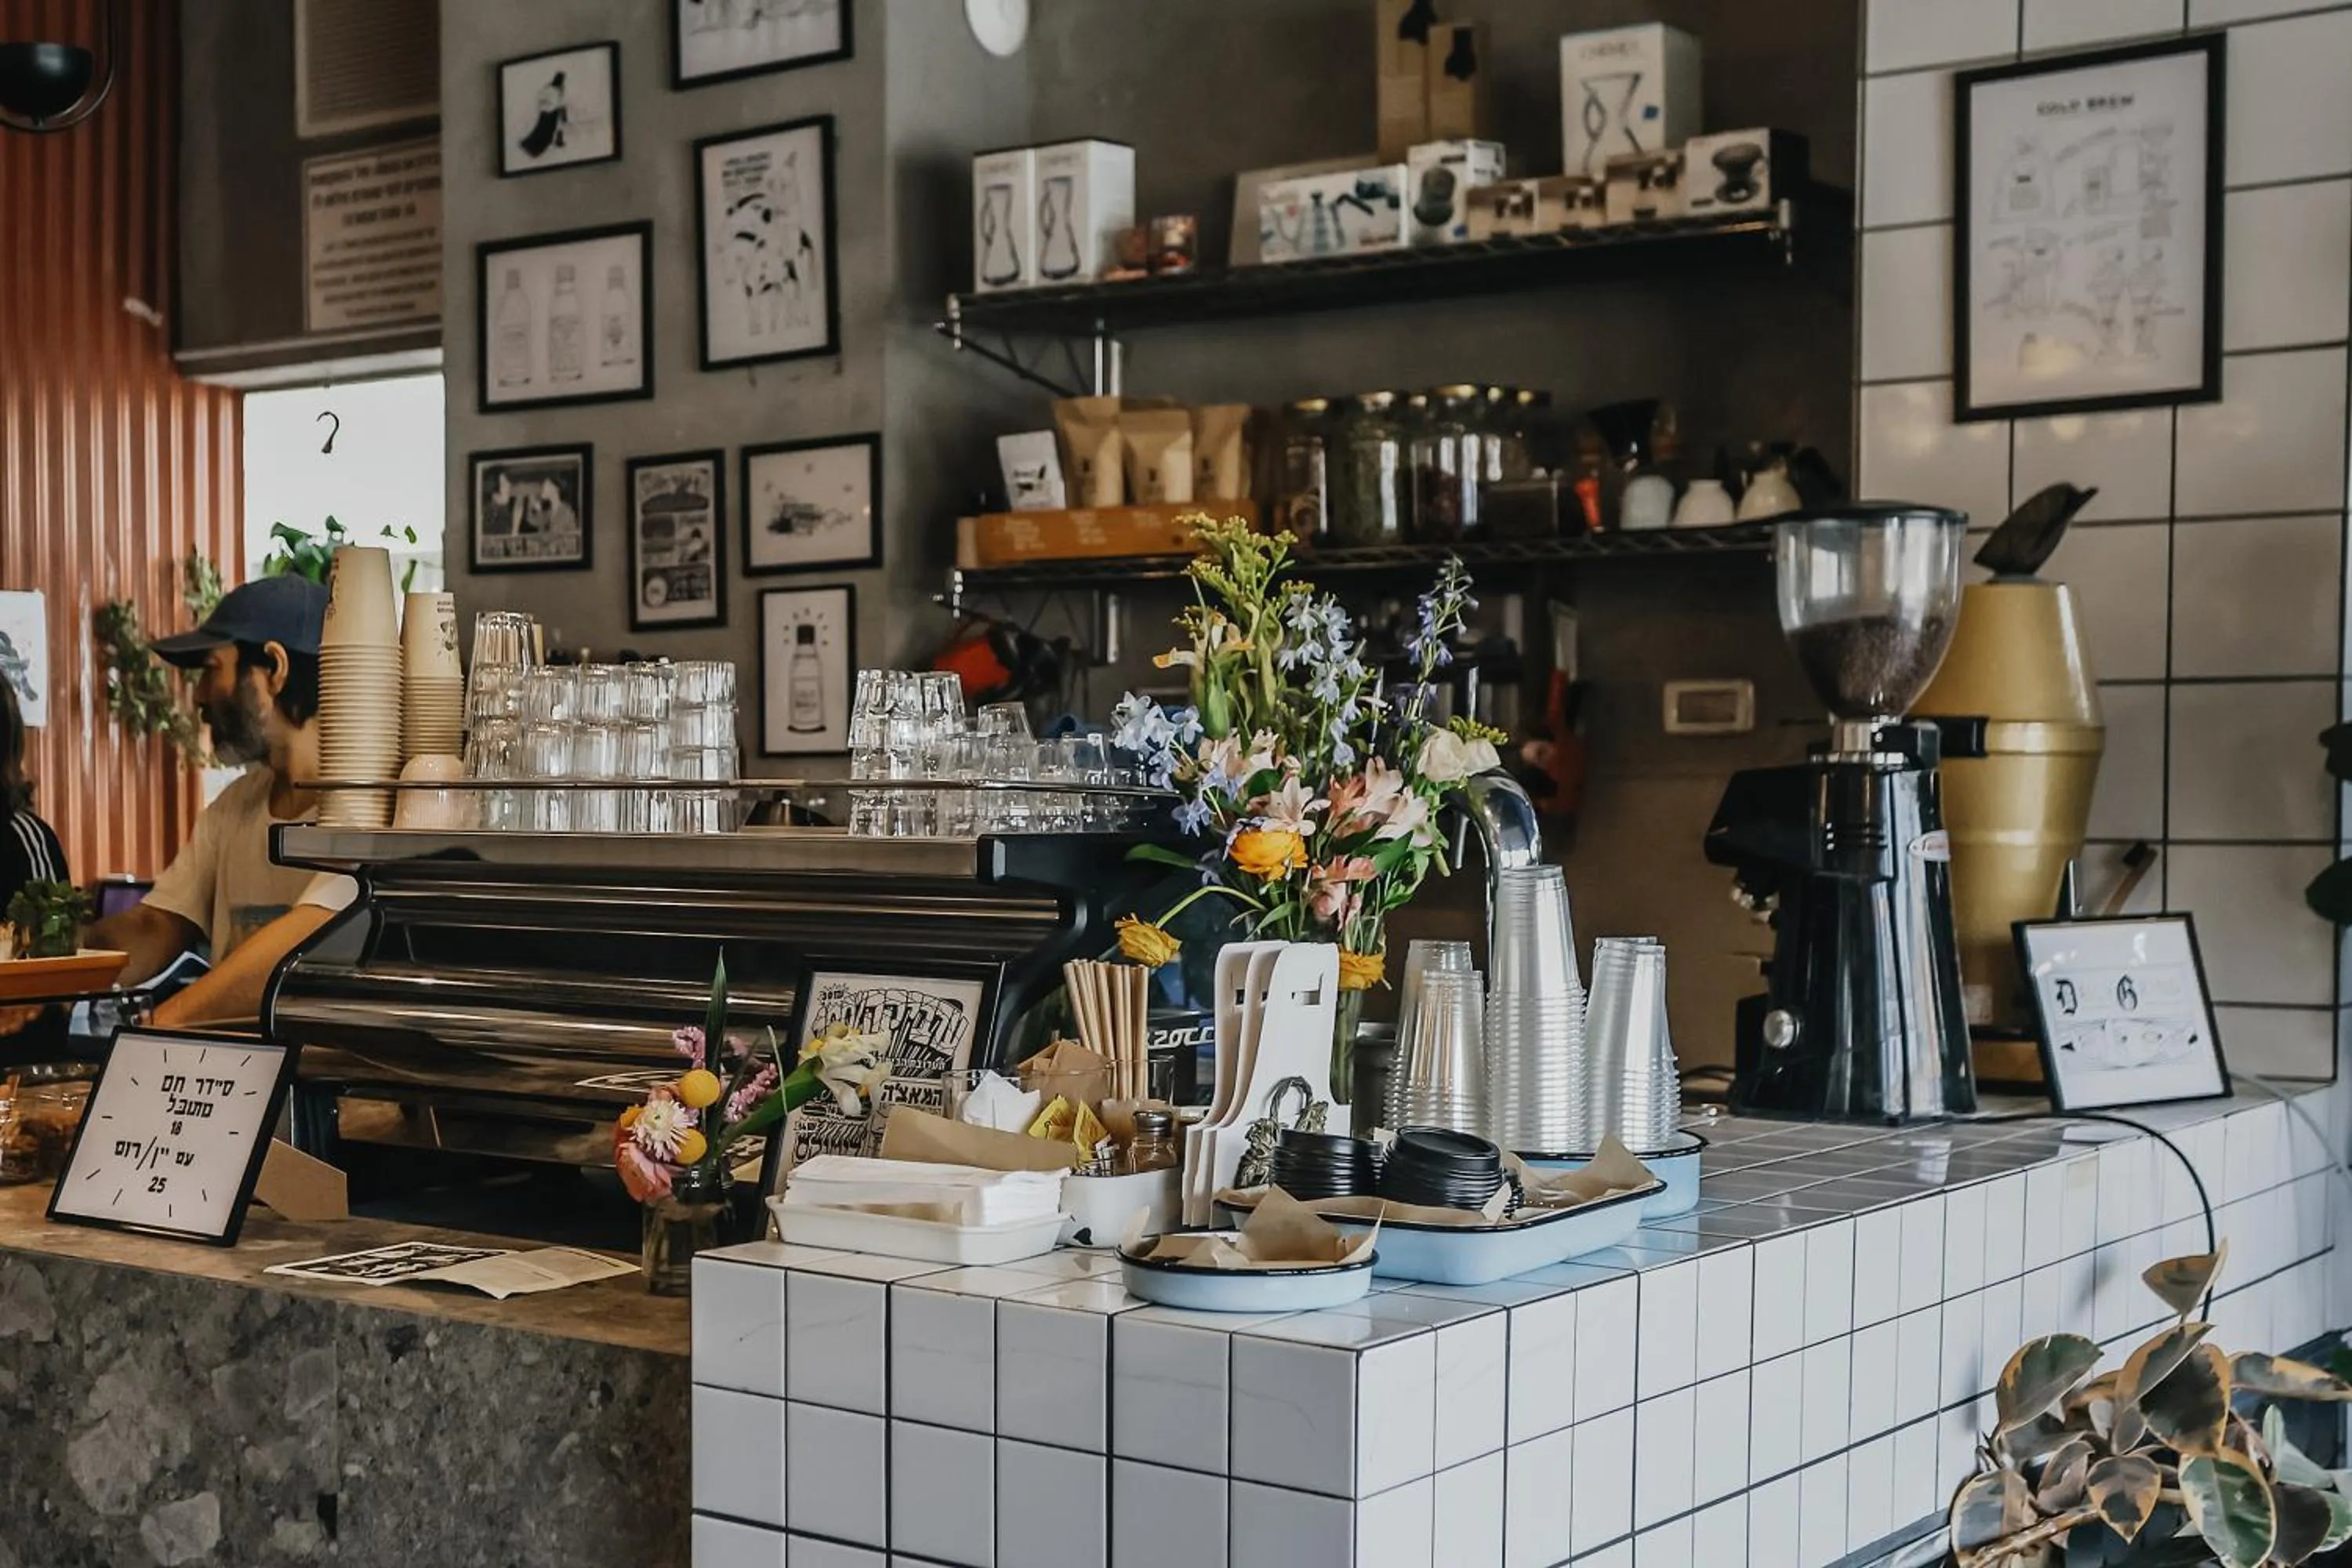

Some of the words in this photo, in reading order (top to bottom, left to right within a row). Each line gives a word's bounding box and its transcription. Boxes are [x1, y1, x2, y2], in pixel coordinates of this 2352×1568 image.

[162, 1075, 186, 1093] חם
[196, 1078, 234, 1096] סיידר
[166, 1093, 213, 1117] מתובל
[170, 1120, 183, 1135] 18
[176, 1152, 194, 1166] עם
[147, 1176, 167, 1193] 25
